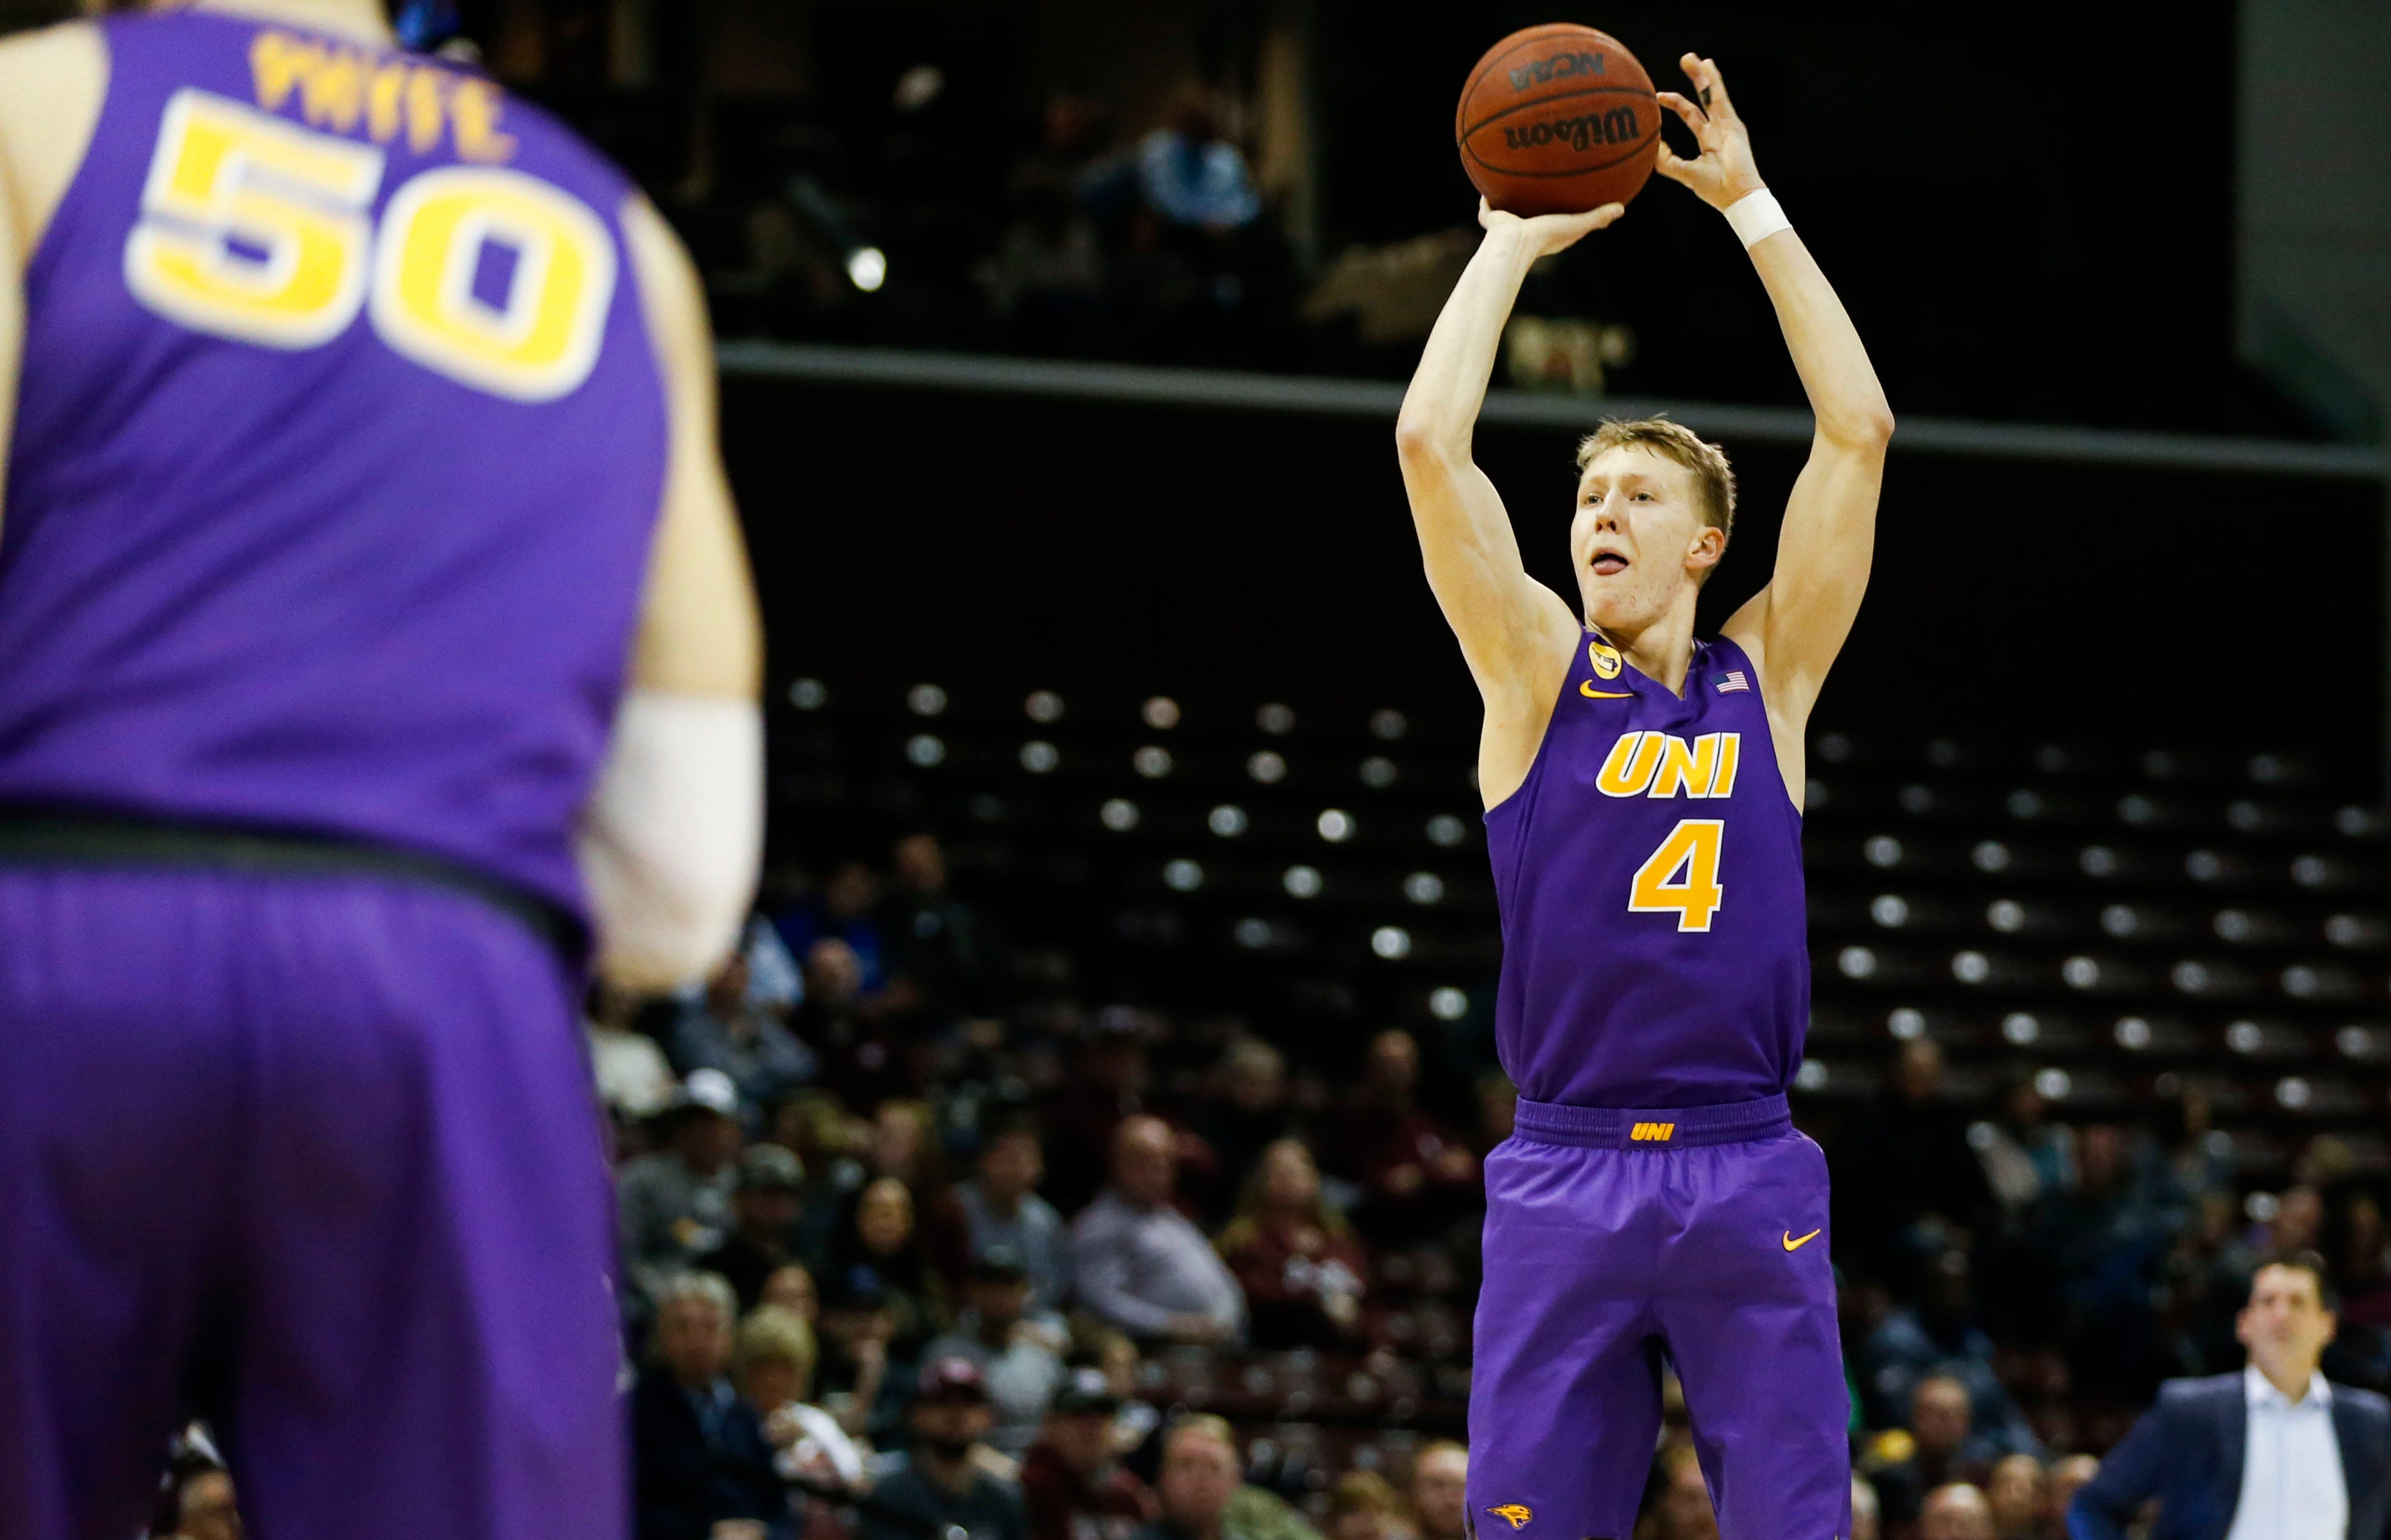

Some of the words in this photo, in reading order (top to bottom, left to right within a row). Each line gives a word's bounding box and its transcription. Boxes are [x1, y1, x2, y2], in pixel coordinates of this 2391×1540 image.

[1510, 53, 1605, 92] NCAA
[1505, 106, 1640, 150] Wilson
[125, 86, 618, 404] 50
[1595, 730, 1741, 798] UNI
[1627, 819, 1725, 932] 4
[1630, 1122, 1675, 1141] UNI
